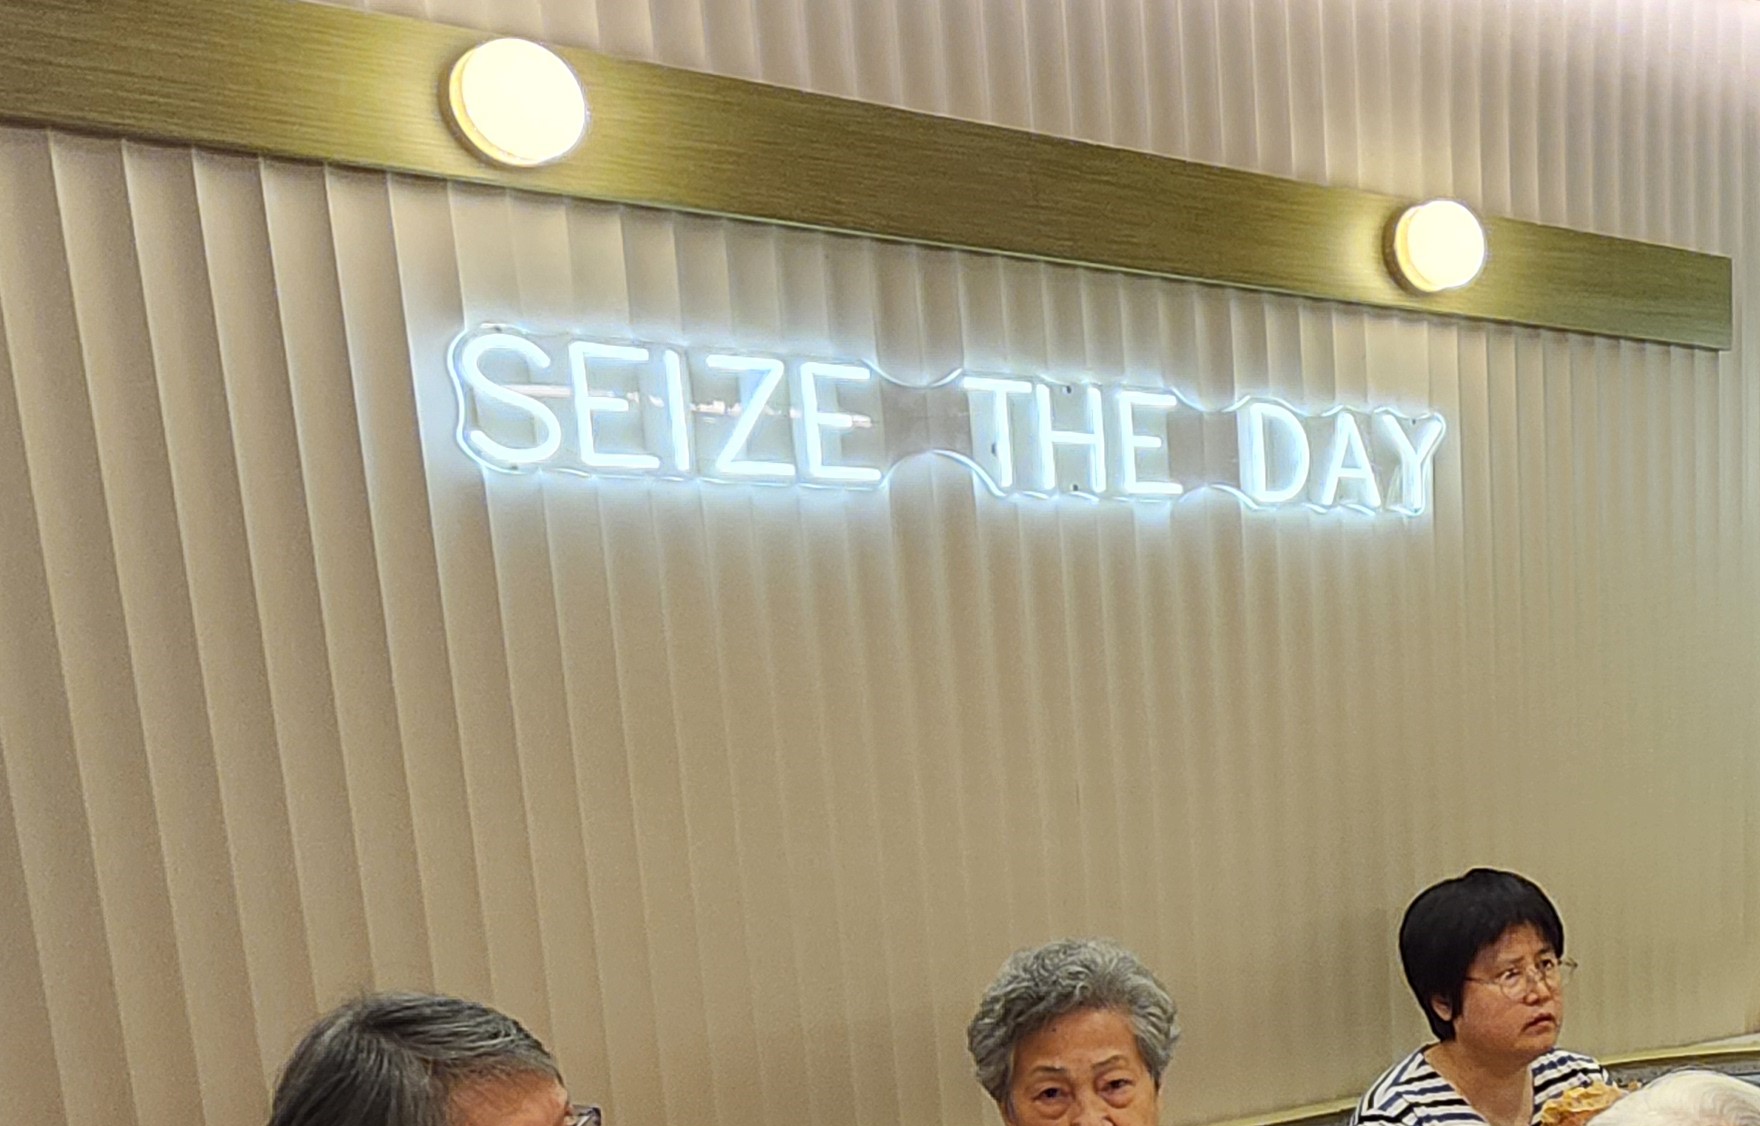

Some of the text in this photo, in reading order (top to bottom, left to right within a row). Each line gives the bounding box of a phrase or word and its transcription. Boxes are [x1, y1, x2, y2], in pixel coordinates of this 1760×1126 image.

[460, 332, 1443, 511] SEIZE THE DAY
